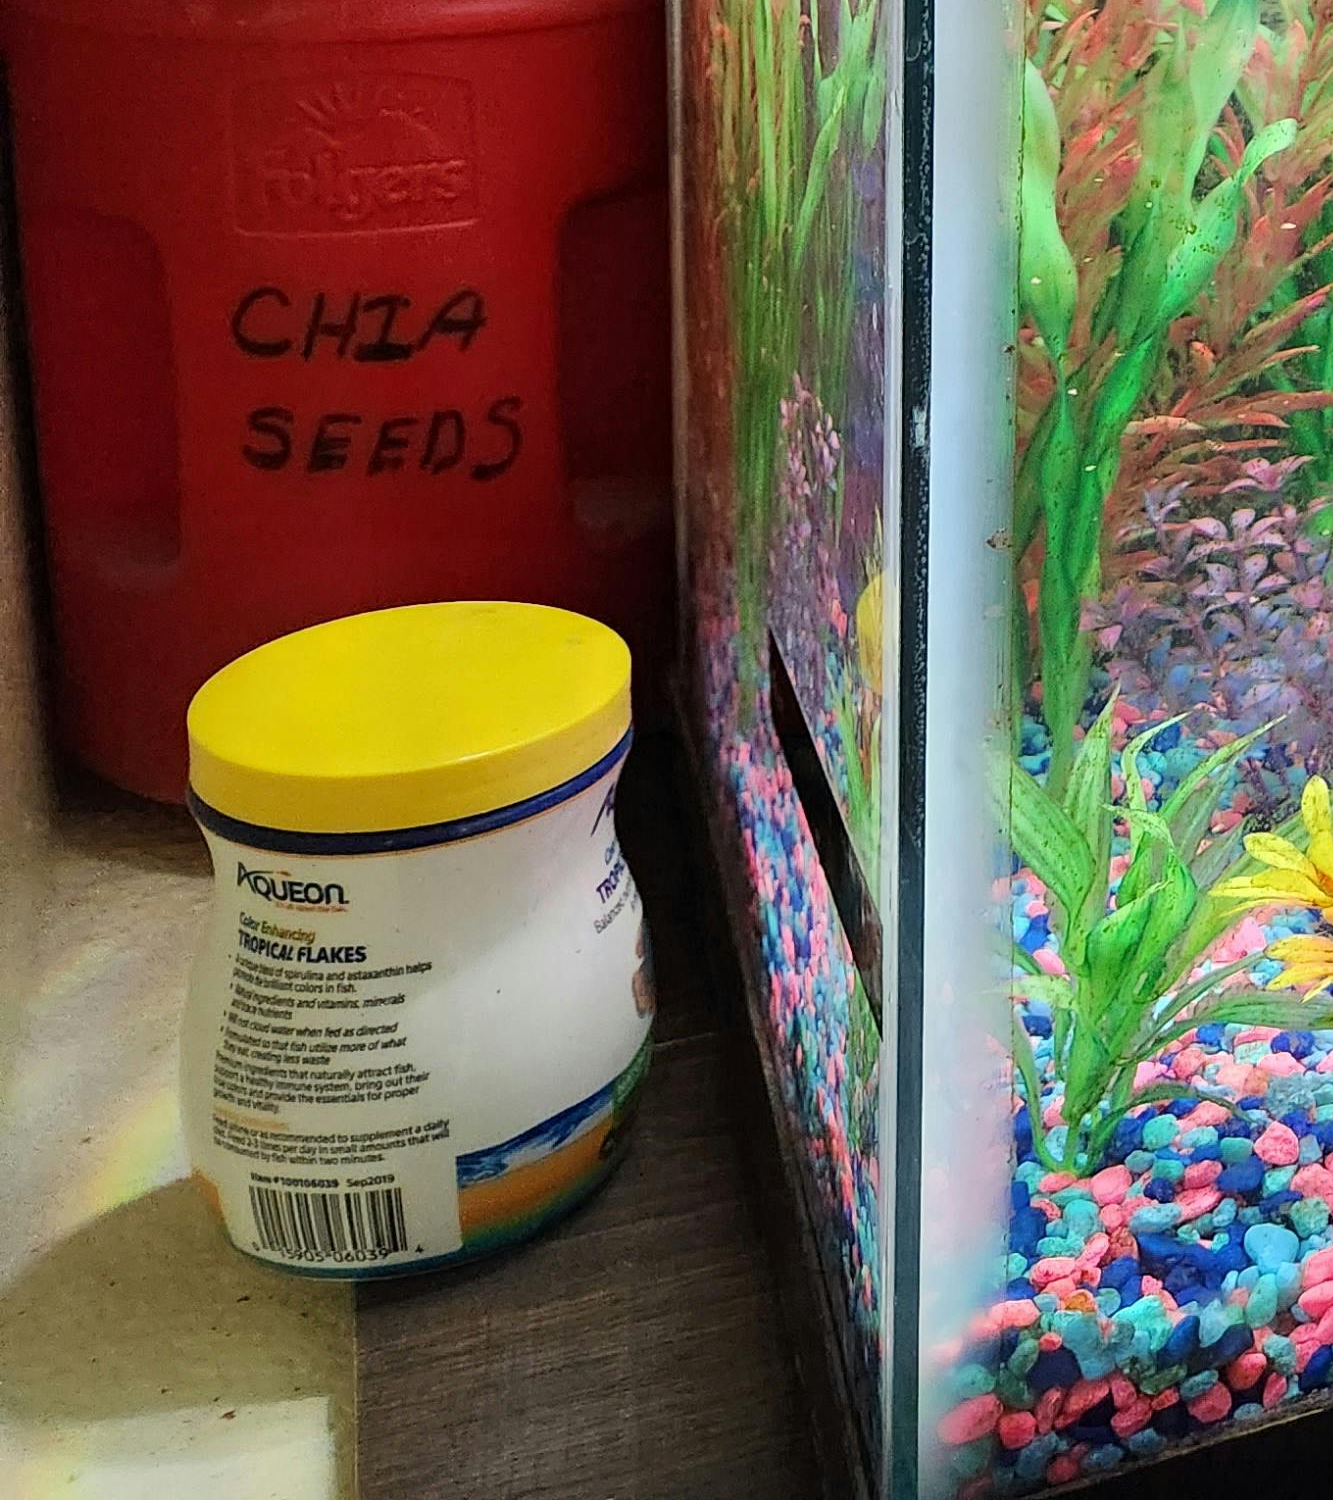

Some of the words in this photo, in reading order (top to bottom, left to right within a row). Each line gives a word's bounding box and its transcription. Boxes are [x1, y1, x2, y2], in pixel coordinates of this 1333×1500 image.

[231, 285, 487, 362] CHIA
[242, 395, 523, 481] SEEDS
[239, 928, 294, 962] TROPICAL
[296, 946, 367, 964] FLAKES
[261, 920, 316, 945] Enhancing
[294, 983, 324, 994] colors
[366, 1091, 382, 1101] for
